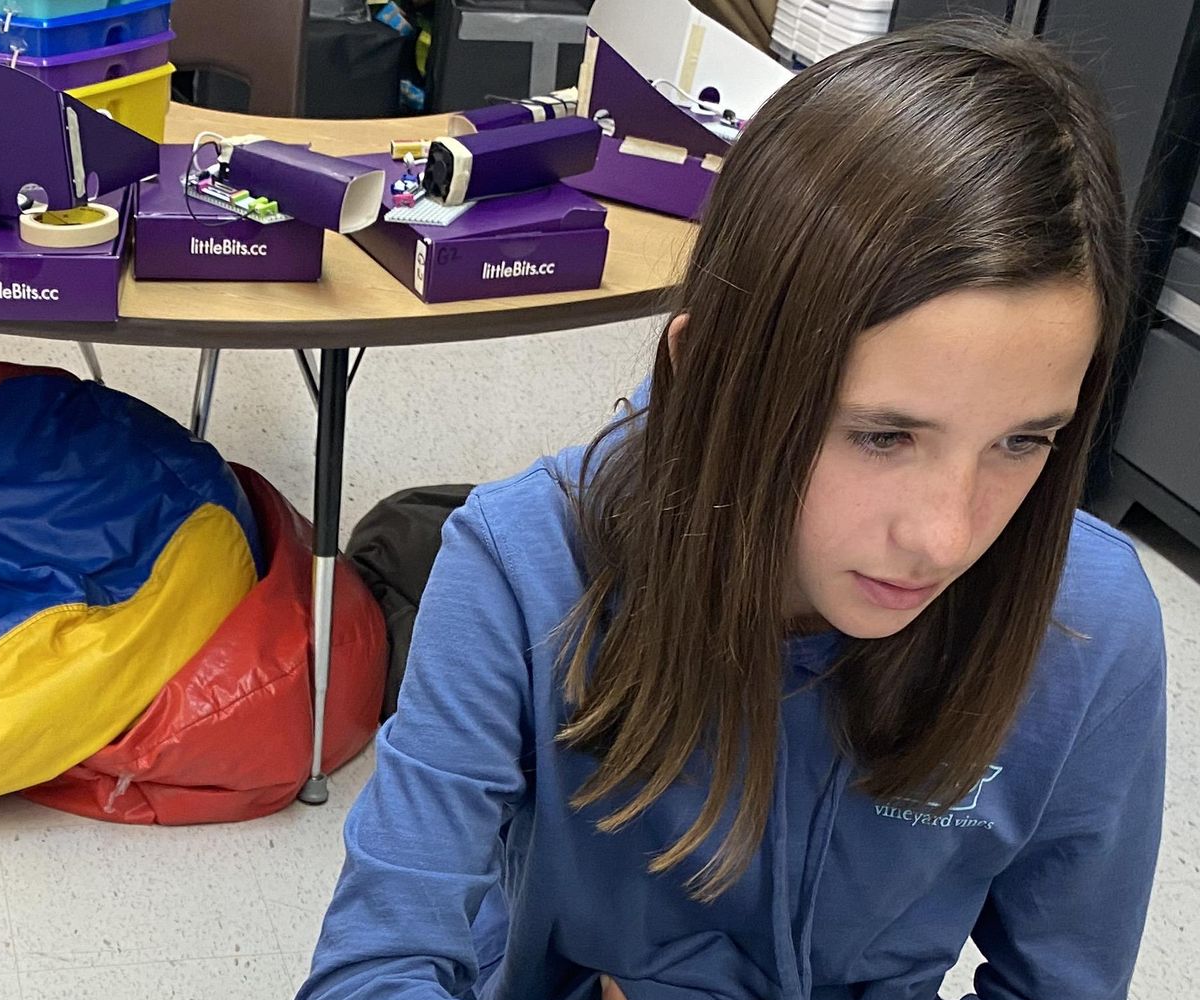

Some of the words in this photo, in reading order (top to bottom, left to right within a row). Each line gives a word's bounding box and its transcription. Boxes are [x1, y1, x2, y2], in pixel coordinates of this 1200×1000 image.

[191, 236, 268, 256] littleBits.cc
[482, 260, 556, 279] littleBits.cc
[874, 803, 954, 827] vineyard
[954, 815, 995, 830] vines
